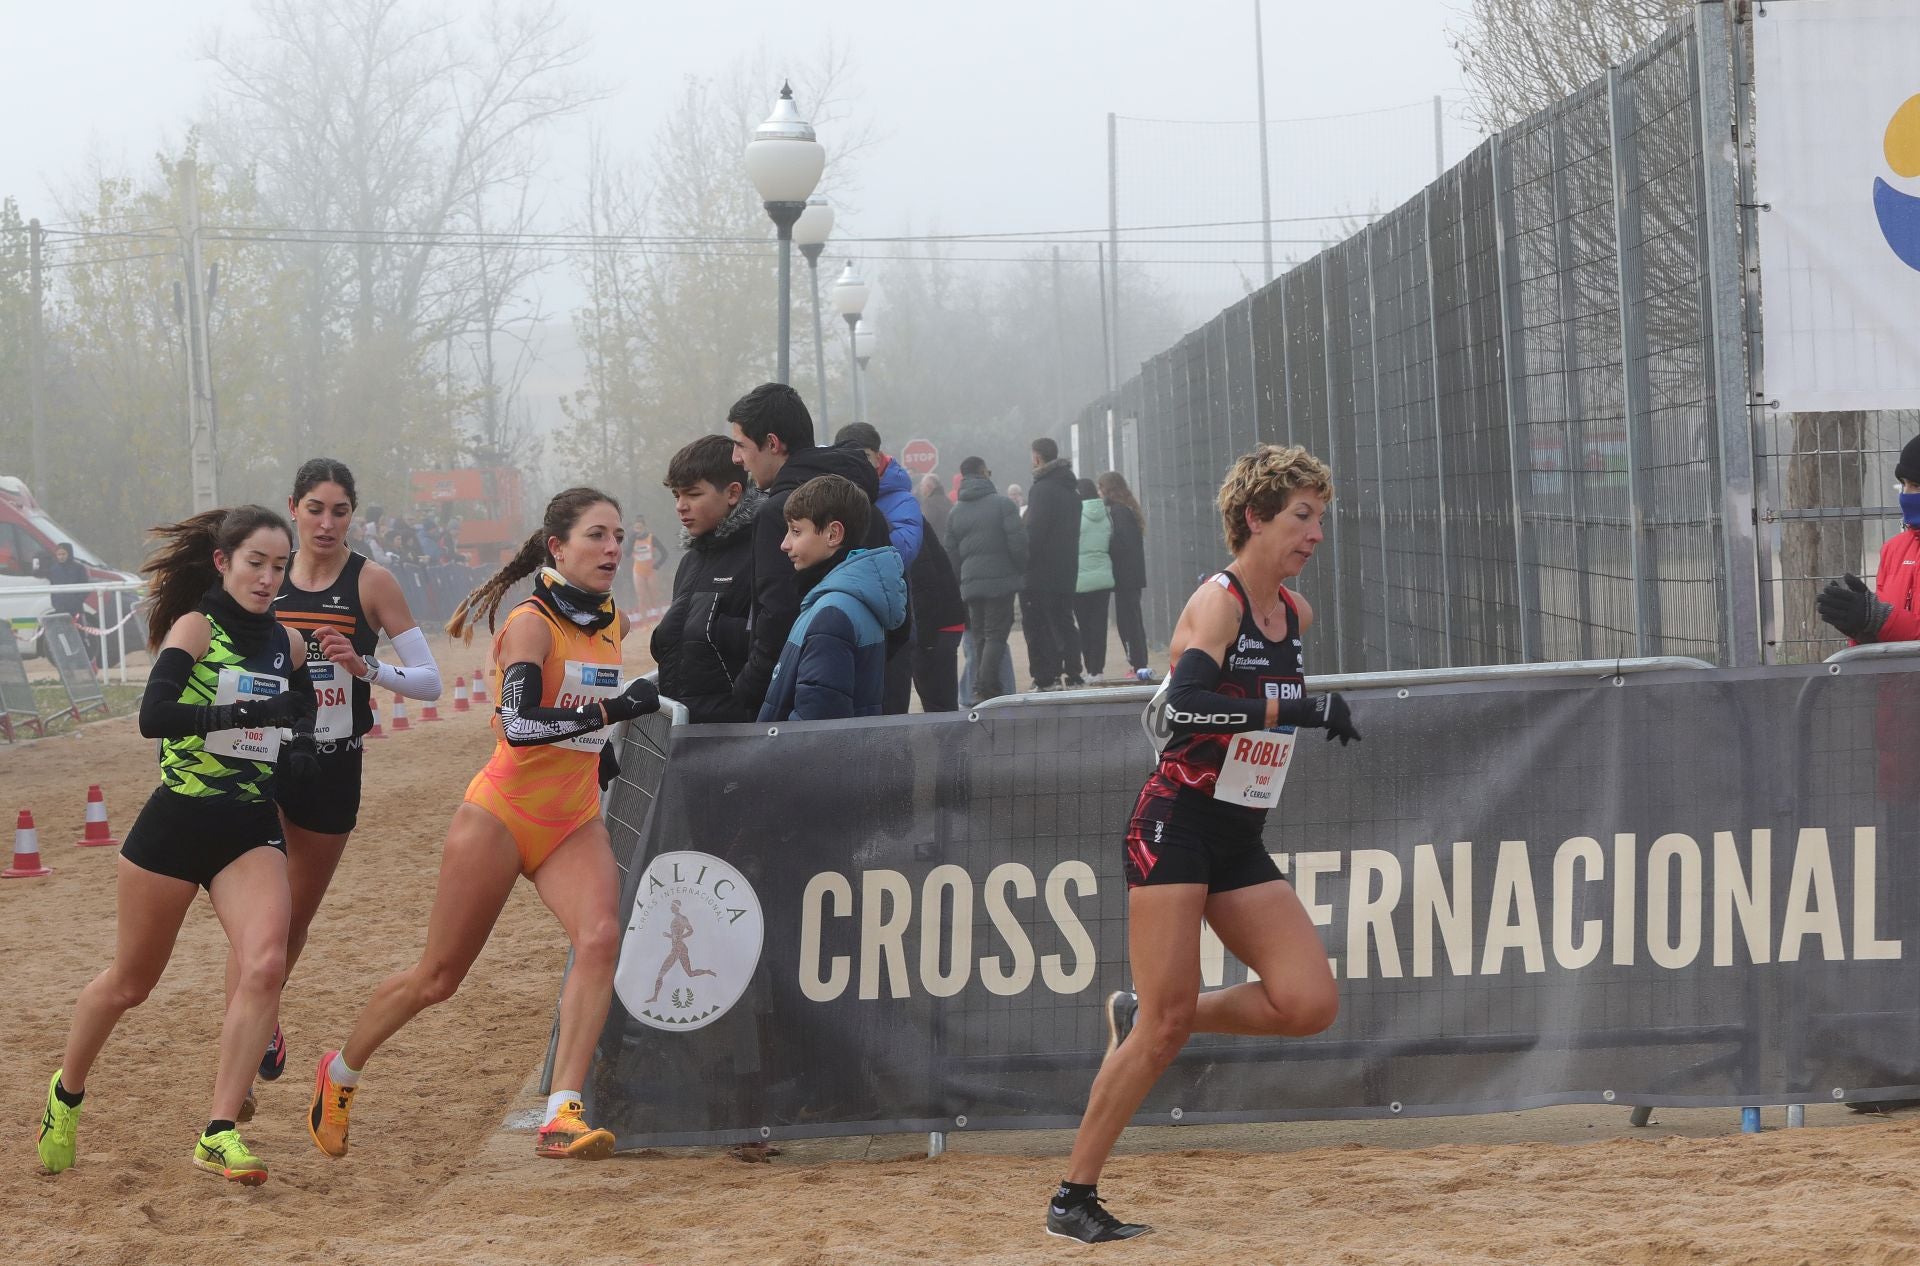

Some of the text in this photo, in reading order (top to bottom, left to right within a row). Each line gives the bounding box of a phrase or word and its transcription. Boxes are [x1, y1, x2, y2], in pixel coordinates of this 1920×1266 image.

[905, 453, 935, 463] STOP
[316, 687, 346, 707] OSA
[1165, 703, 1248, 725] COROS
[244, 731, 263, 741] 1003
[578, 736, 605, 745] CEREALTO
[240, 744, 269, 754] CEREALTO
[1233, 737, 1289, 768] ROBLE
[1255, 775, 1271, 786] 1001
[798, 826, 1902, 1002] CROSS ERNACIONAL
